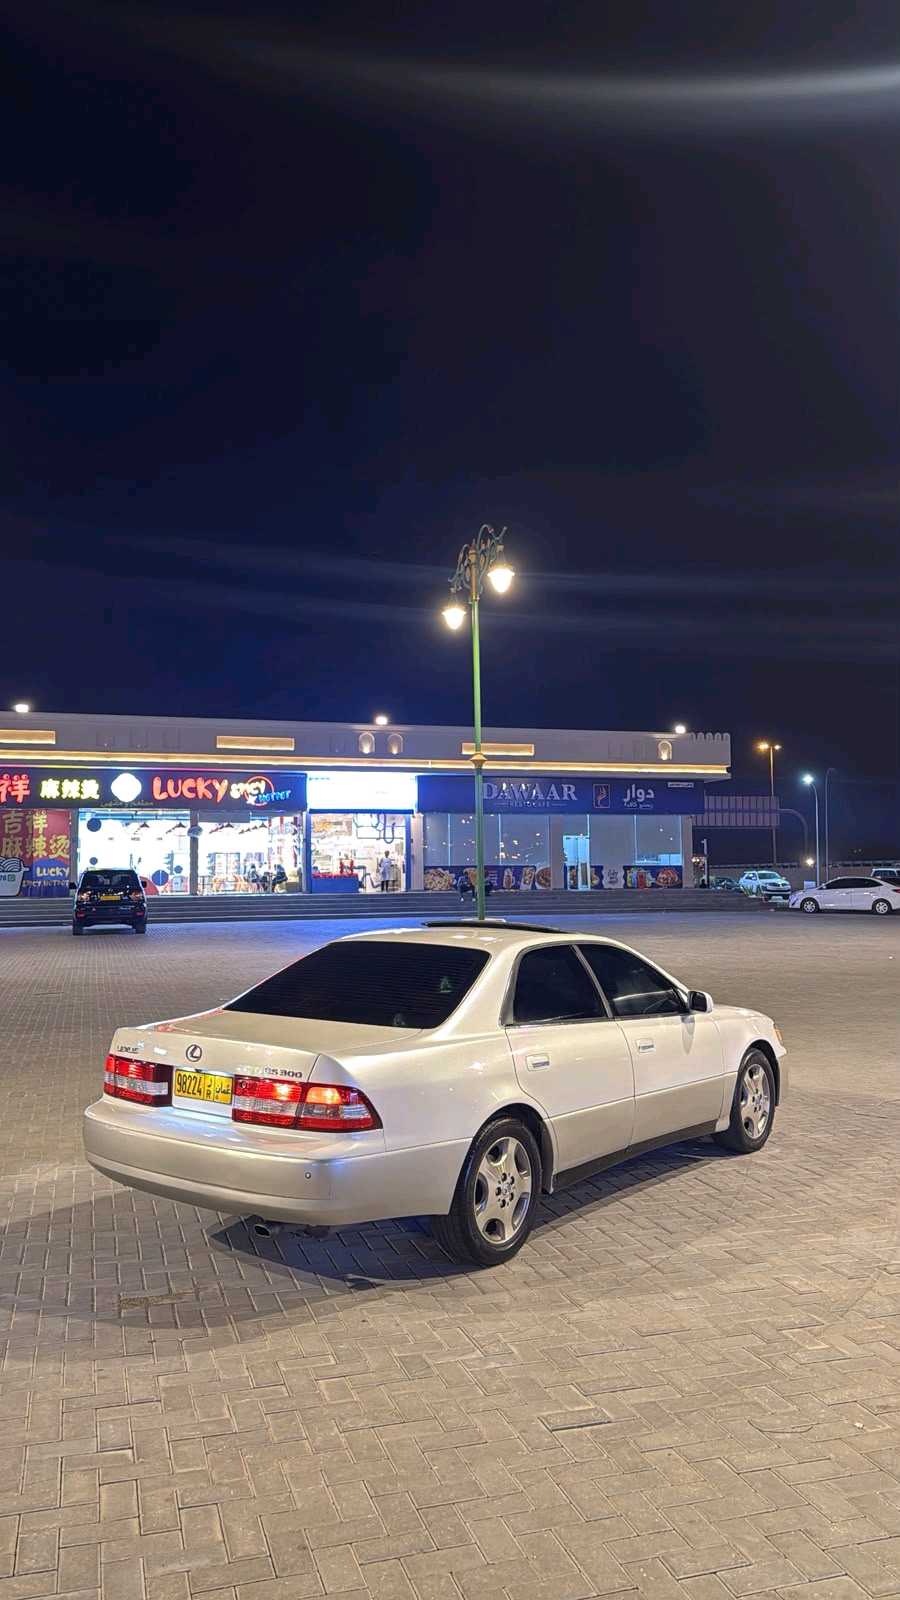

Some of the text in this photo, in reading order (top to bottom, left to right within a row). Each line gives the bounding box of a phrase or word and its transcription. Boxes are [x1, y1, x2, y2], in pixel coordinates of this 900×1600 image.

[152, 776, 229, 803] LUCKY
[483, 782, 578, 801] DAWAAR
[623, 783, 655, 803] دوار
[36, 866, 70, 877] LUCKY
[176, 1072, 203, 1097] 98224
